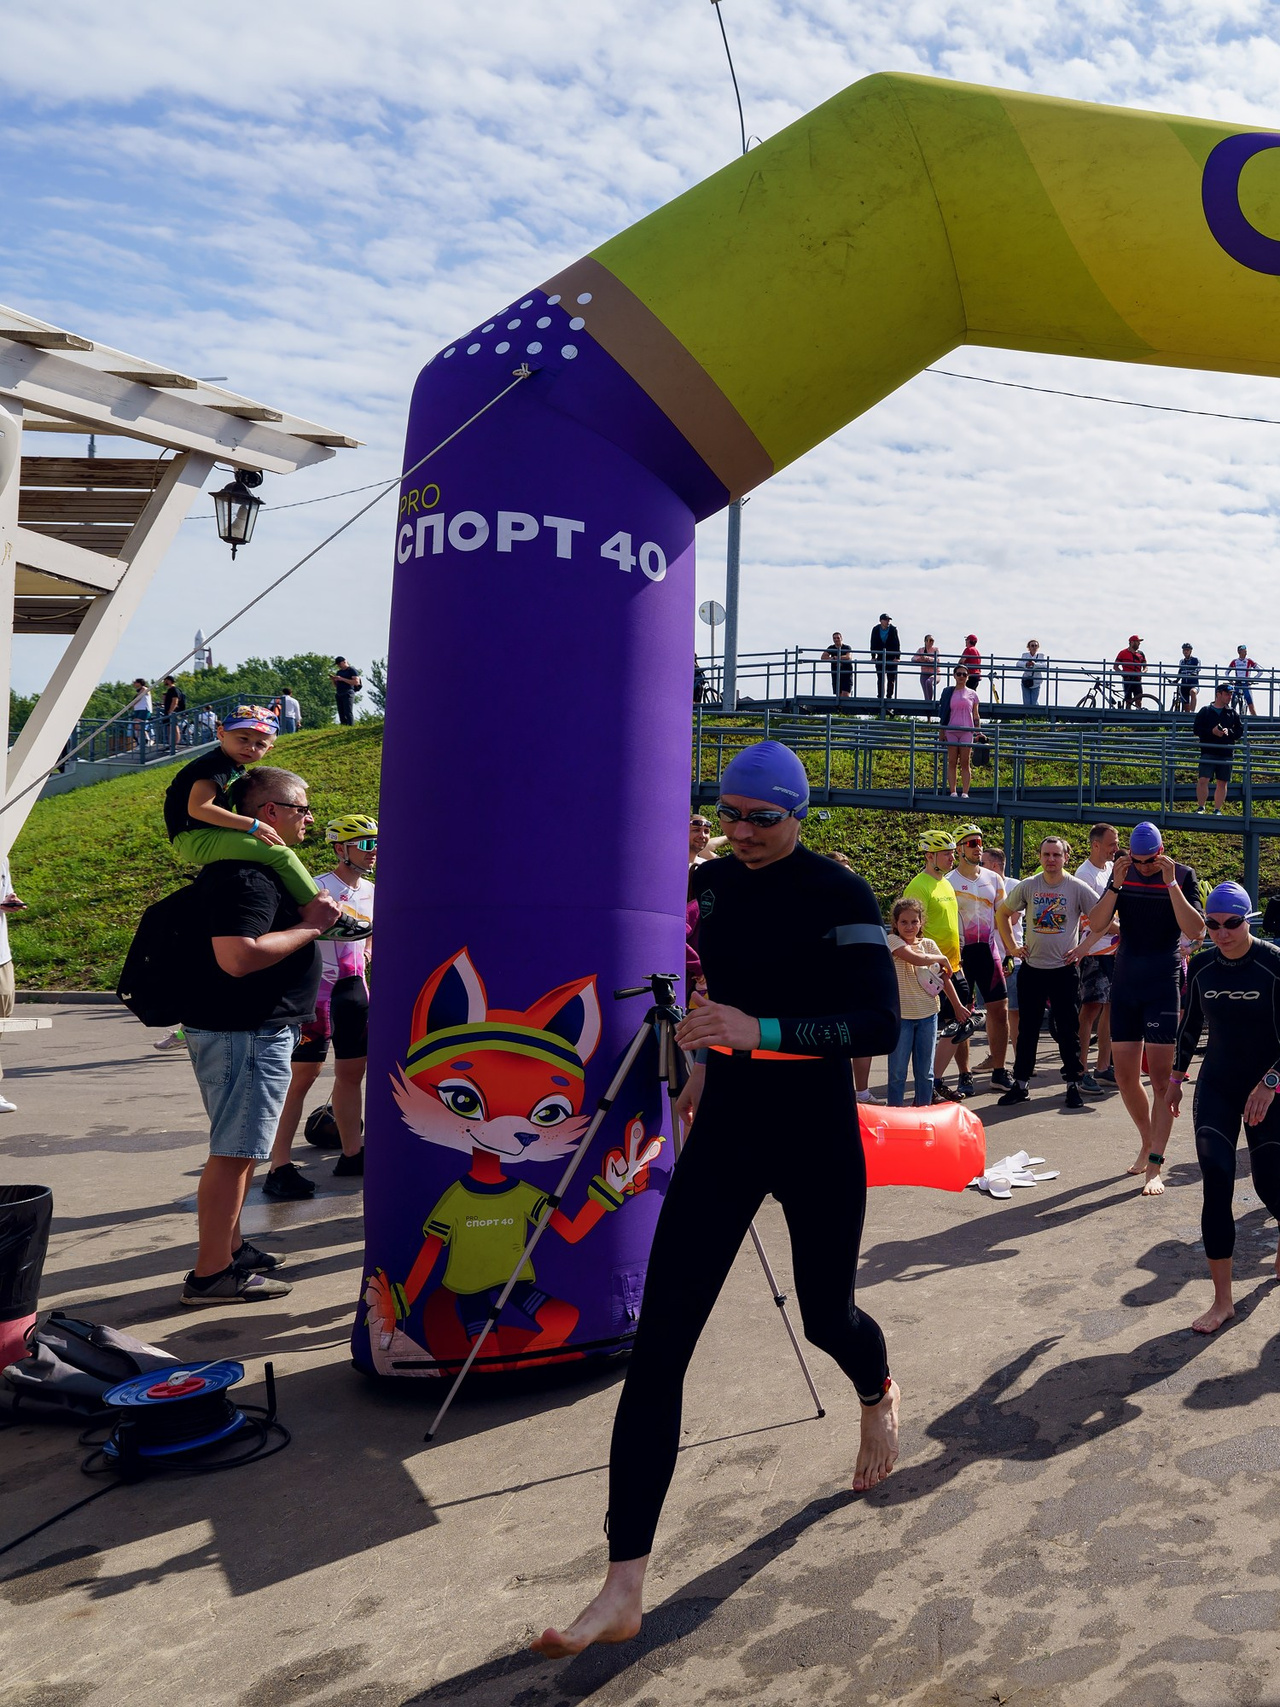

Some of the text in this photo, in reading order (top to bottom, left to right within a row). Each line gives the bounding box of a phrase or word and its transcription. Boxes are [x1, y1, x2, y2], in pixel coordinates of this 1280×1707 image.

[399, 483, 441, 522] PRO
[397, 510, 667, 582] СПОРТ 40
[1204, 990, 1261, 1000] orca
[466, 1219, 499, 1227] СПОРТ
